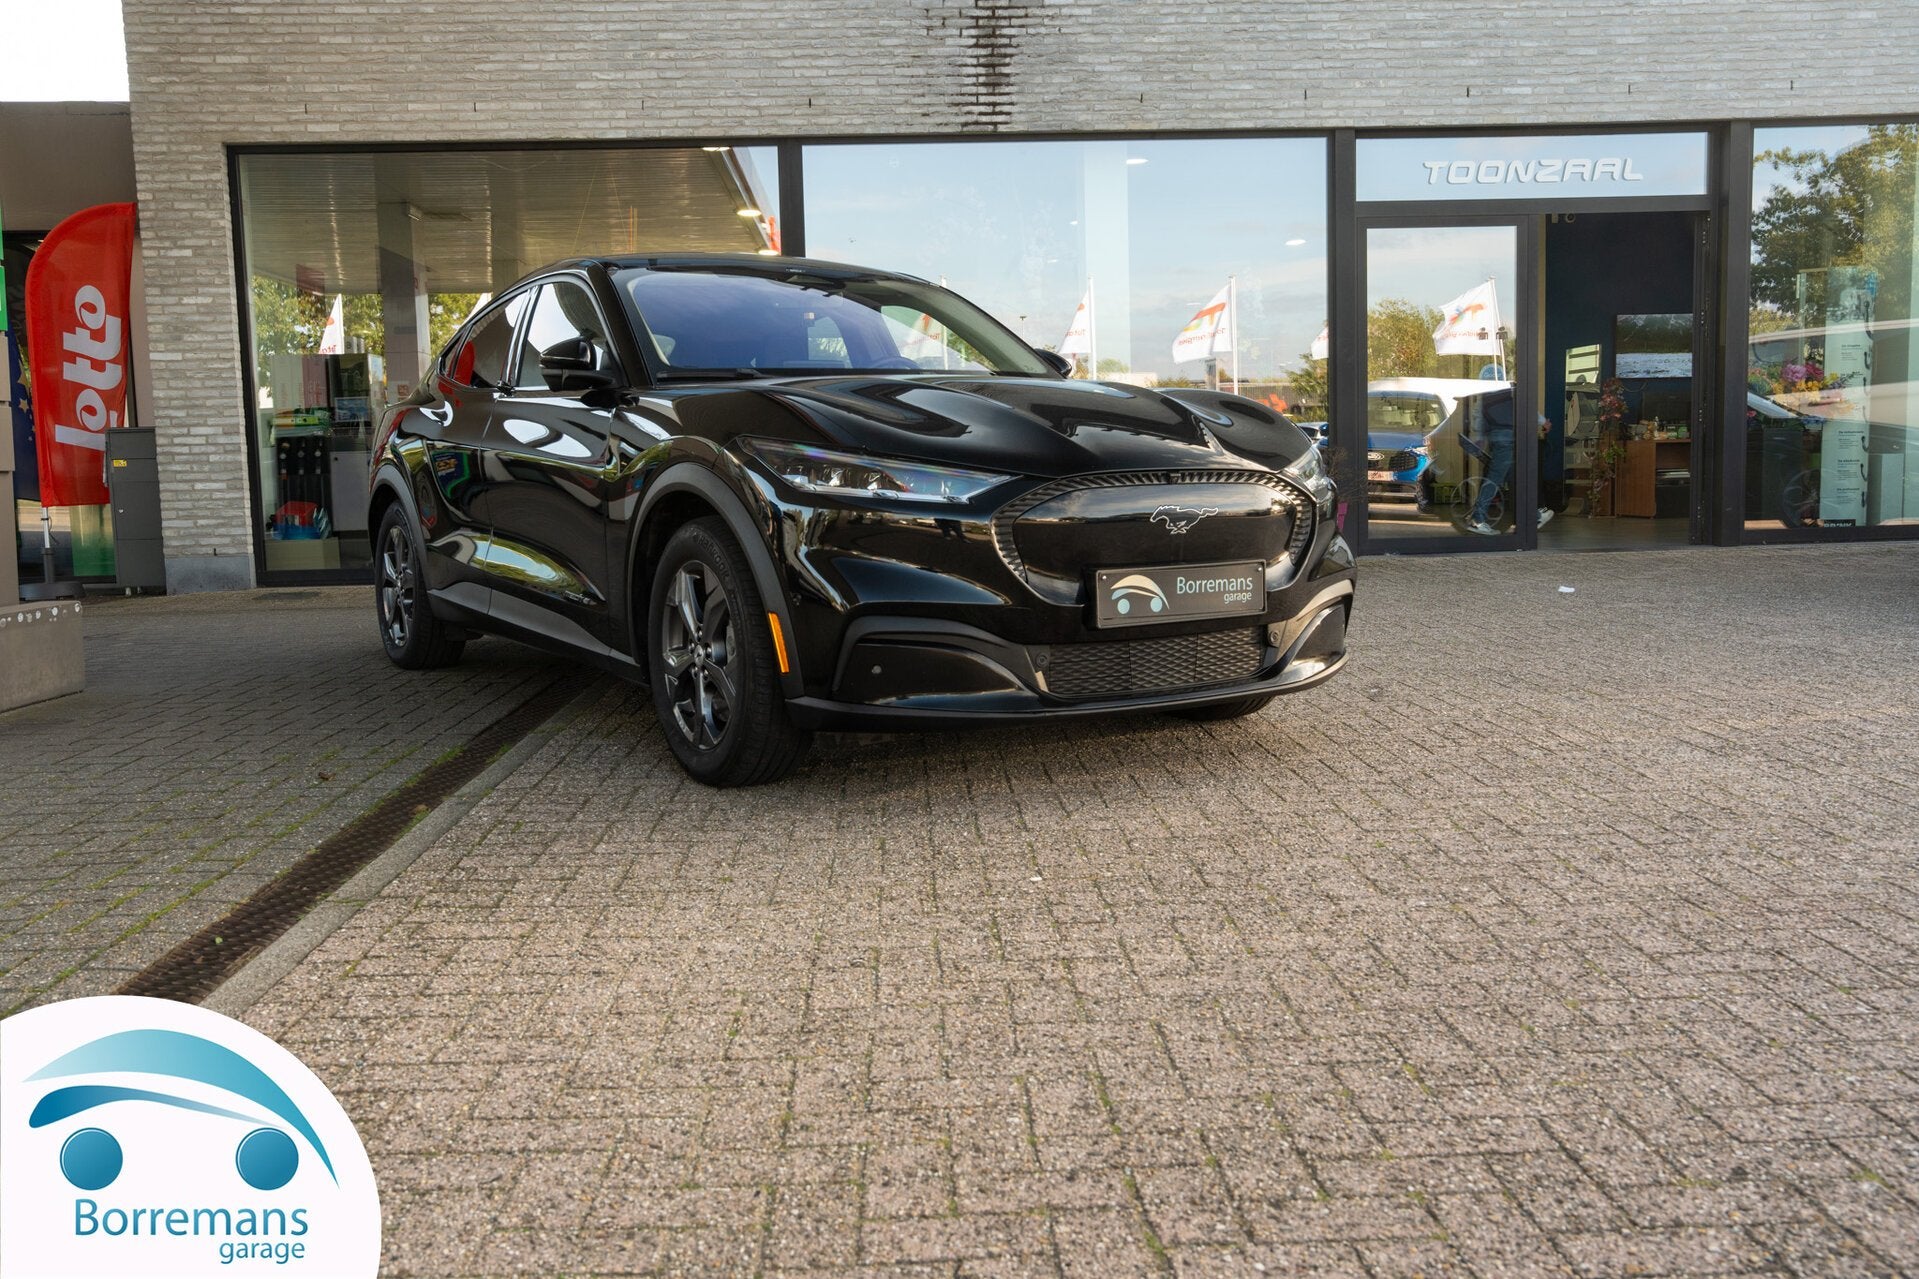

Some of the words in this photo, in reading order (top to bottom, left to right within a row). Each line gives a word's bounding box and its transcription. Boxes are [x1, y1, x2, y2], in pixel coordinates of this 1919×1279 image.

[1423, 157, 1643, 184] TOONZAAL
[1176, 576, 1253, 594] Borremans
[1223, 592, 1252, 605] garage
